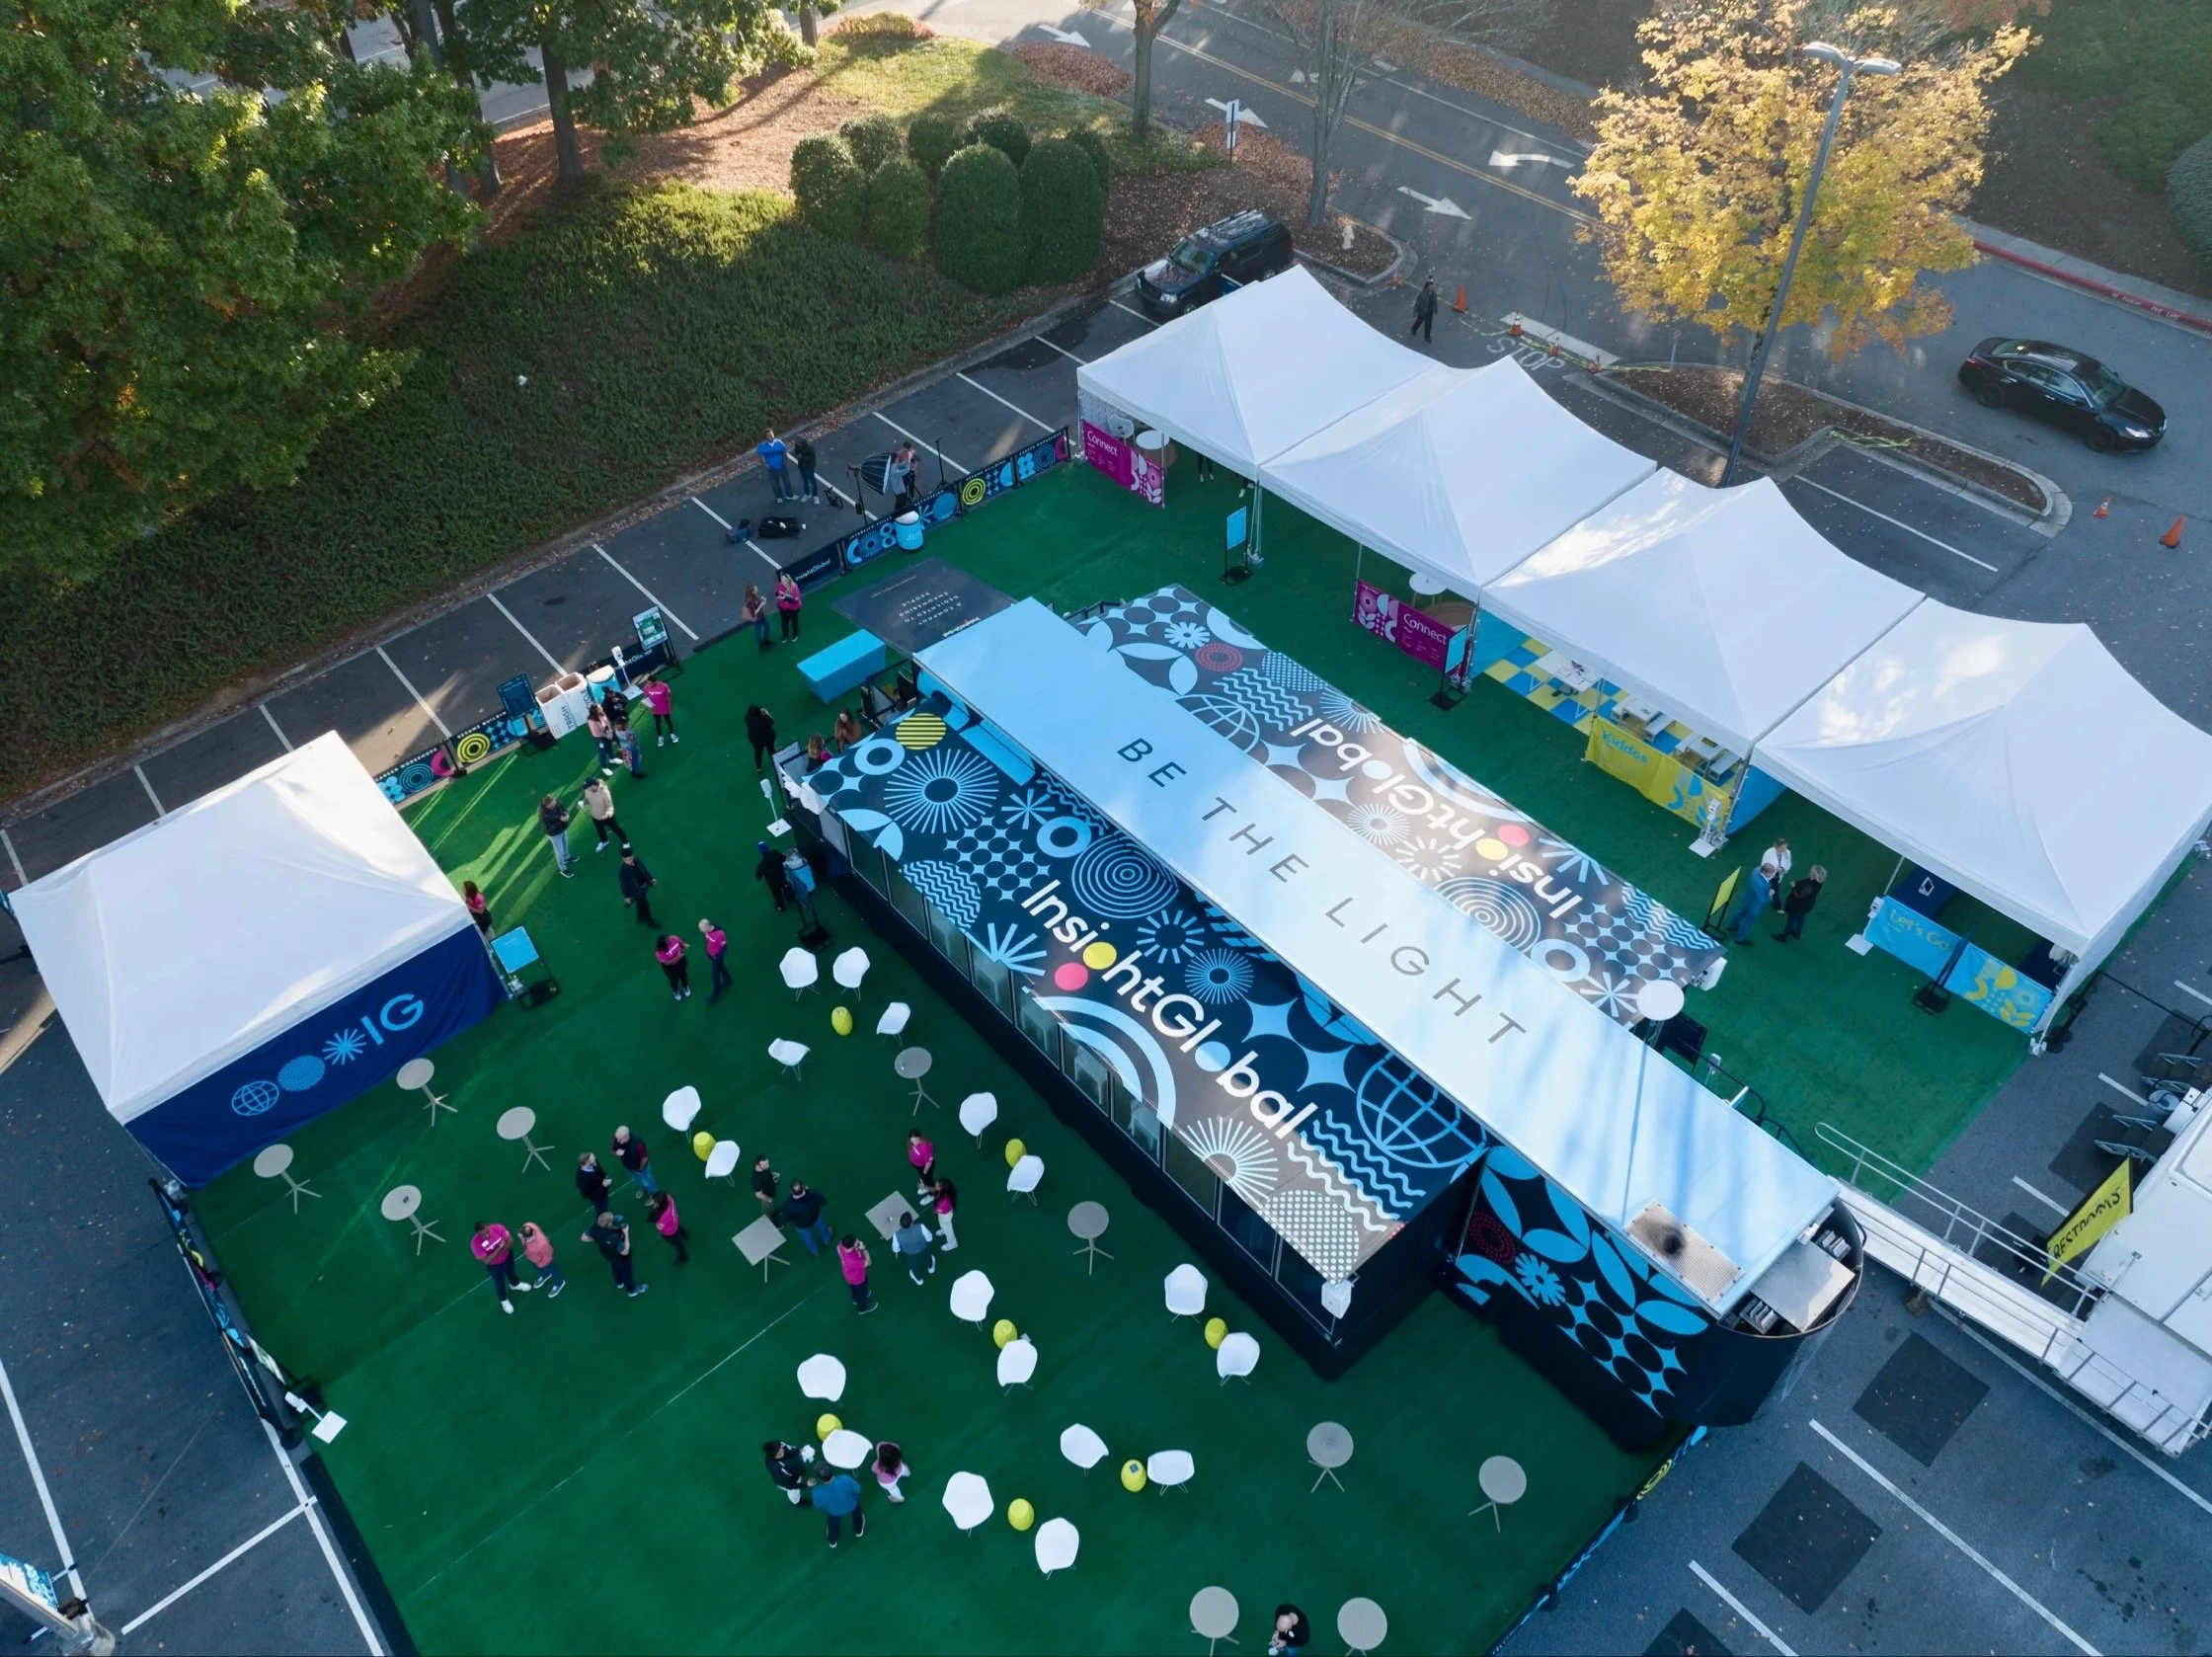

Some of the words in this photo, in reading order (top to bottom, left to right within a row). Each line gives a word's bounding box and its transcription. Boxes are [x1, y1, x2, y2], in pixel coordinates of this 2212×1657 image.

[1486, 338, 1565, 371] STOP
[1087, 430, 1118, 457] Connect
[899, 591, 949, 617] EMPOWERING
[902, 592, 930, 607] PEOPLE
[1403, 612, 1447, 646] Connect
[482, 710, 508, 727] BUILDIN
[560, 705, 575, 731] TRASH
[1602, 730, 1648, 764] Kiddos
[1290, 718, 1583, 919] InsightGlobal
[1116, 737, 1187, 788] BE
[1201, 796, 1310, 883] THE
[1324, 897, 1528, 1045] LIGHT
[1890, 907, 1924, 936] Let's
[1927, 931, 1951, 951] Go
[360, 993, 425, 1046] IG
[1020, 879, 1318, 1140] InsightGlobal
